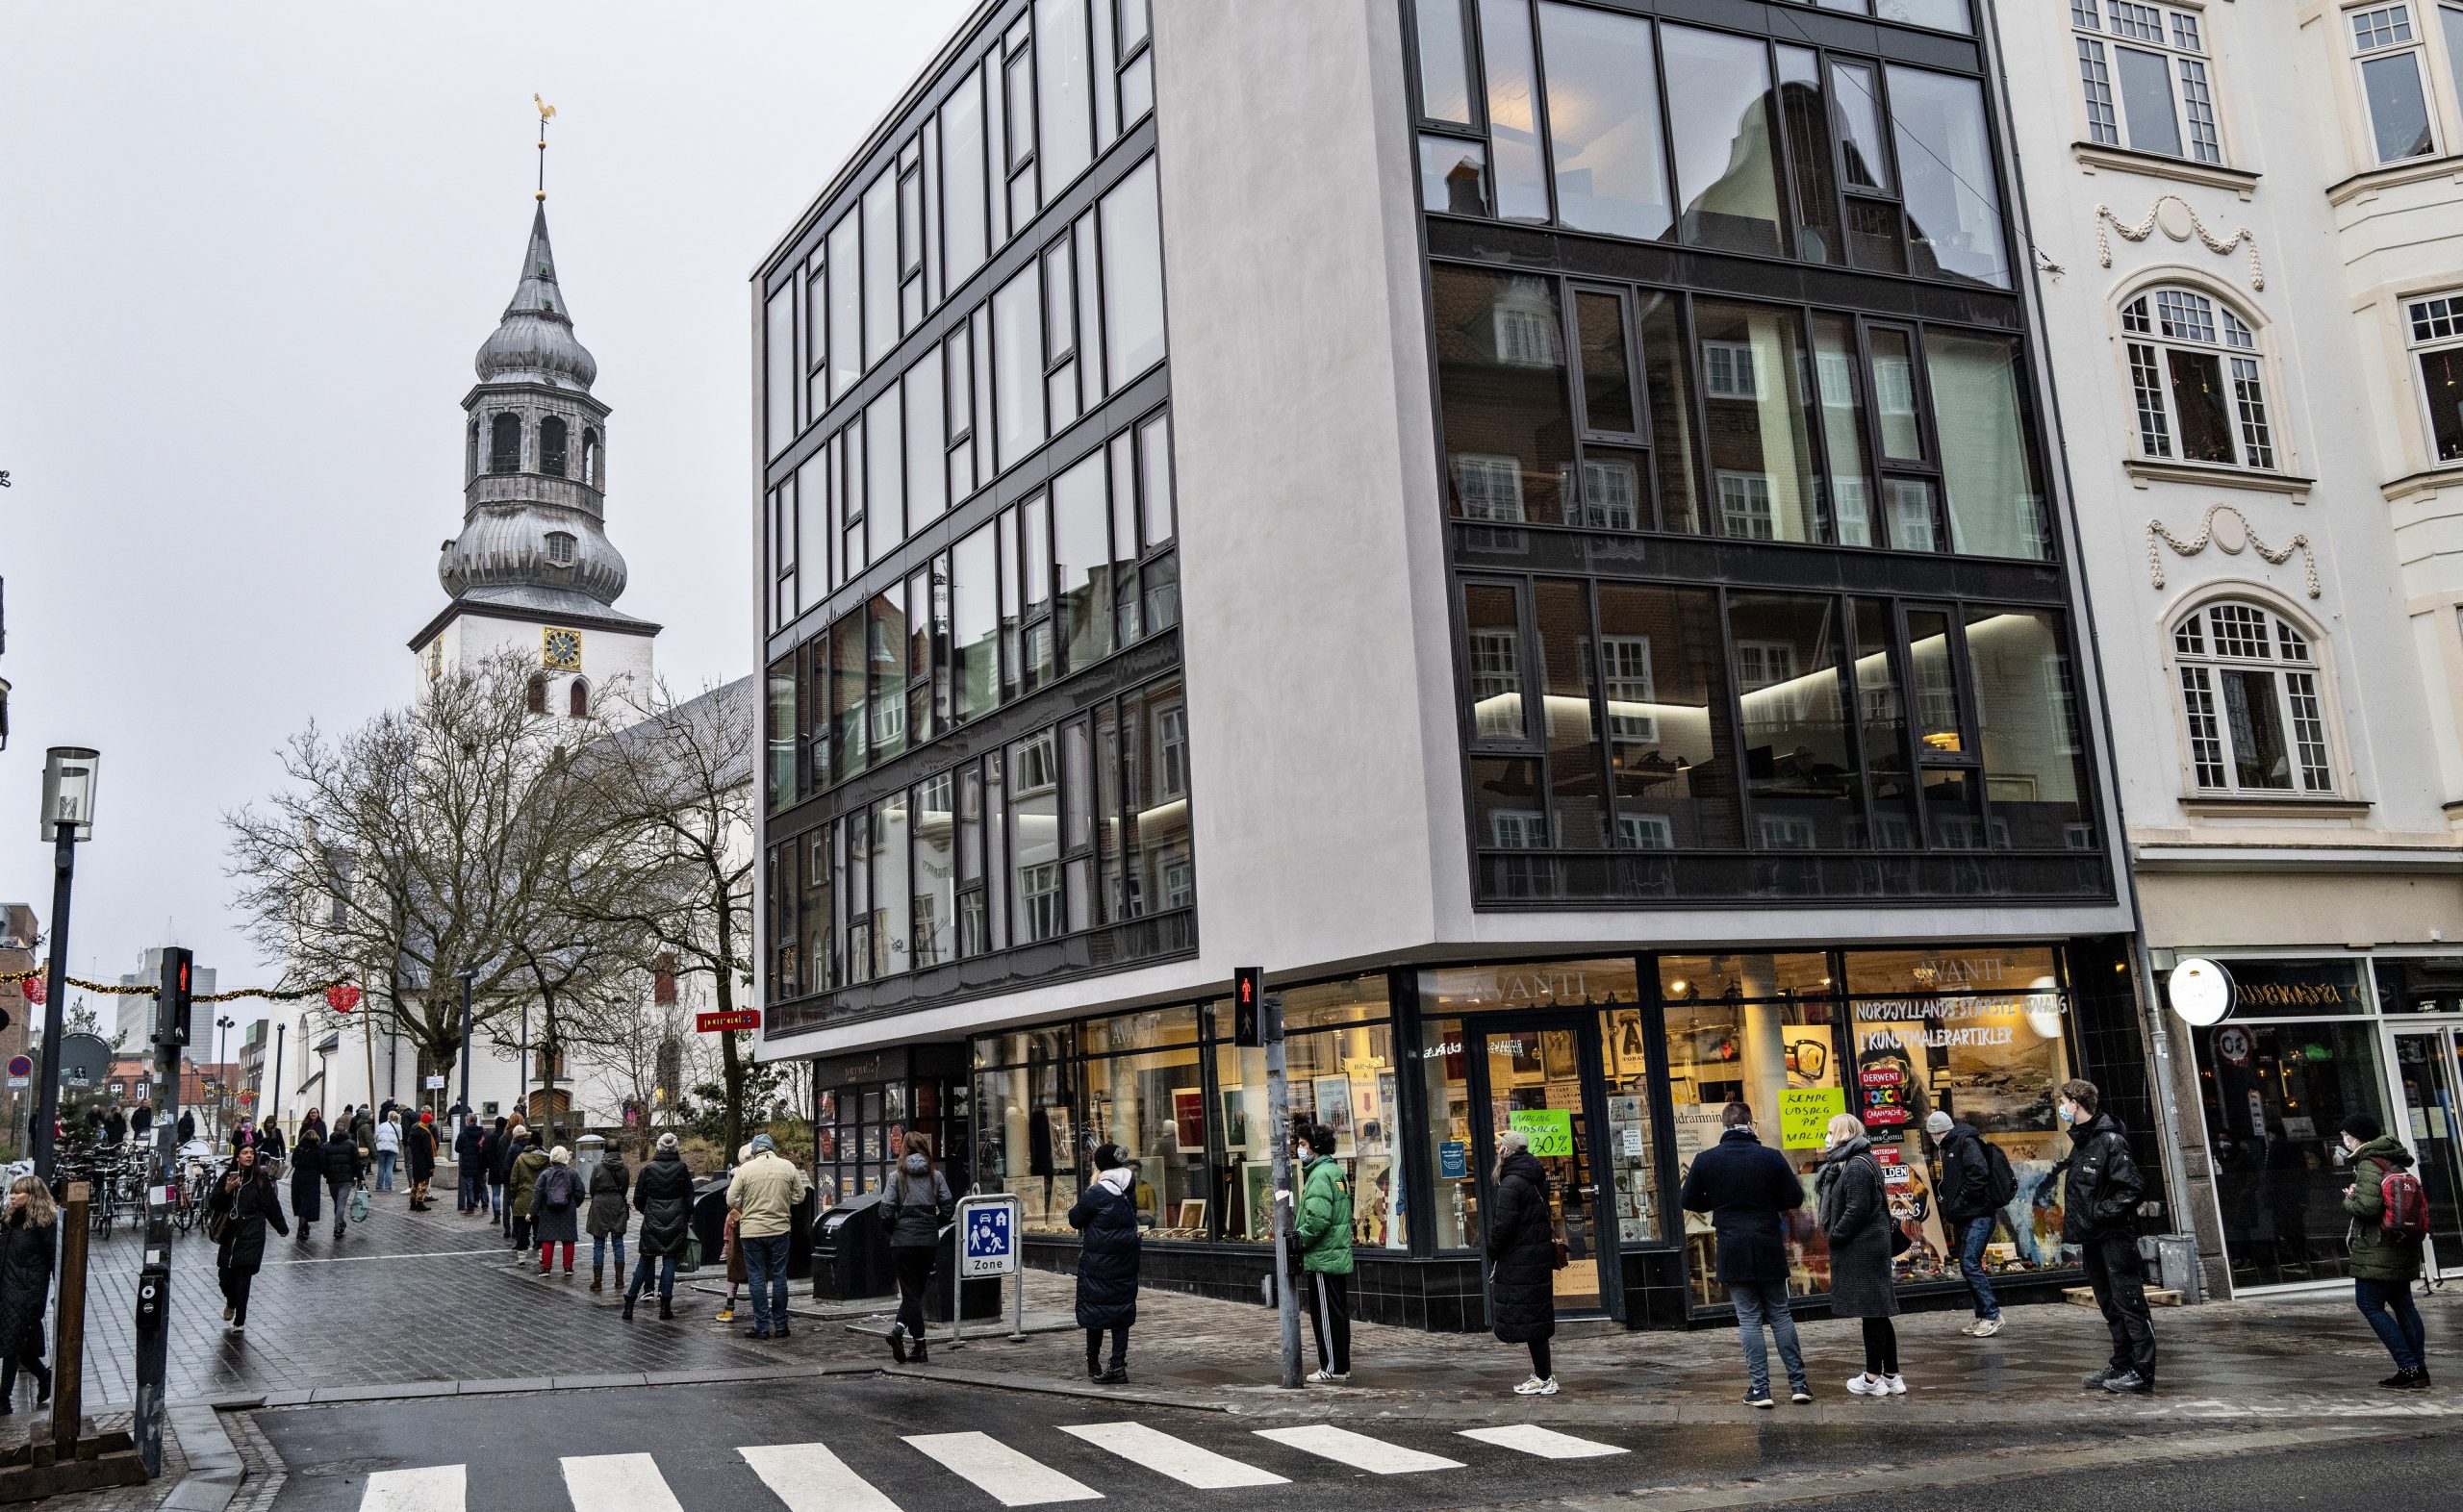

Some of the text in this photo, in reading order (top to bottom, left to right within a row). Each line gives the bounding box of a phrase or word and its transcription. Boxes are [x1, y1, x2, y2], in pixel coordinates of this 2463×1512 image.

[1917, 957, 2003, 982] AVANTI
[1471, 971, 1588, 1002] AVANTI
[1856, 998, 1955, 1021] NORDJYLLANDS
[1960, 997, 2017, 1017] STØRSTE
[704, 1015, 751, 1028] paradis
[1859, 1026, 2013, 1051] I KUNSTMALERARTIKLER
[1864, 1072, 1898, 1082] DERWENT
[1788, 1095, 1828, 1103] KEMPE
[1864, 1089, 1902, 1104] POSCA
[1785, 1107, 1830, 1116] UDSALG
[1516, 1114, 1551, 1122] MALING
[1802, 1117, 1819, 1126] PÅ
[1513, 1125, 1559, 1134] UDSALG
[1867, 1133, 1904, 1143] FABER-CASTELL
[974, 1260, 1003, 1270] Zone
